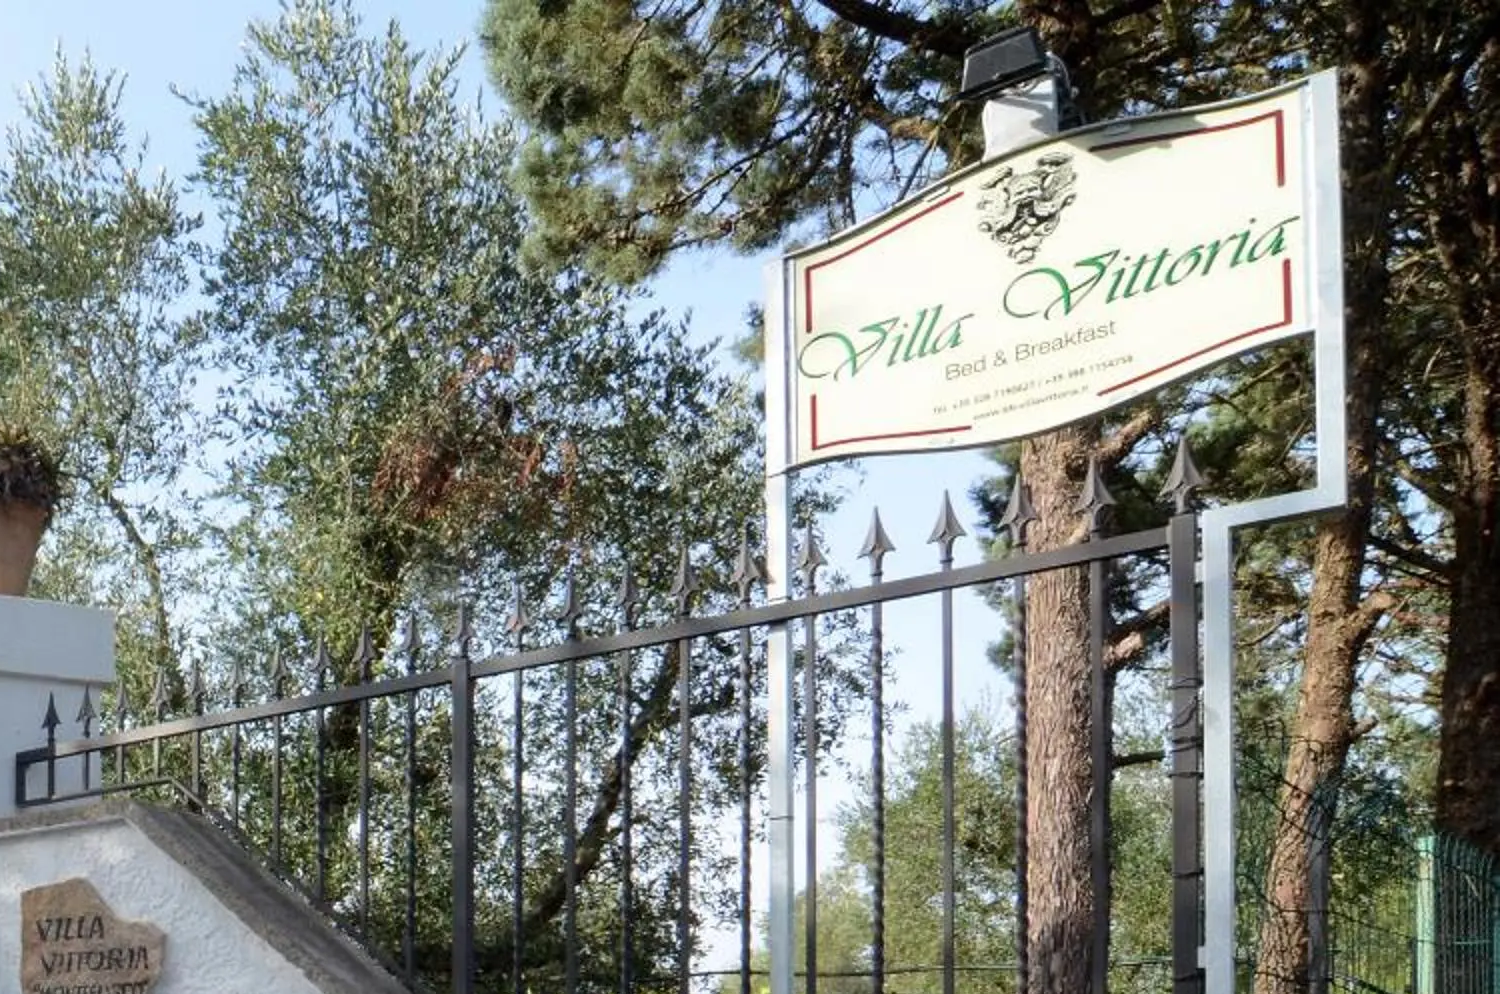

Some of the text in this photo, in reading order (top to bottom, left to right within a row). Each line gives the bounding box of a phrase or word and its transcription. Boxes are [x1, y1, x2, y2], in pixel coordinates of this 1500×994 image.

[798, 215, 1300, 382] Villa Vittoria
[945, 321, 1116, 381] Bed & Breakfast
[36, 915, 105, 942] VILLA
